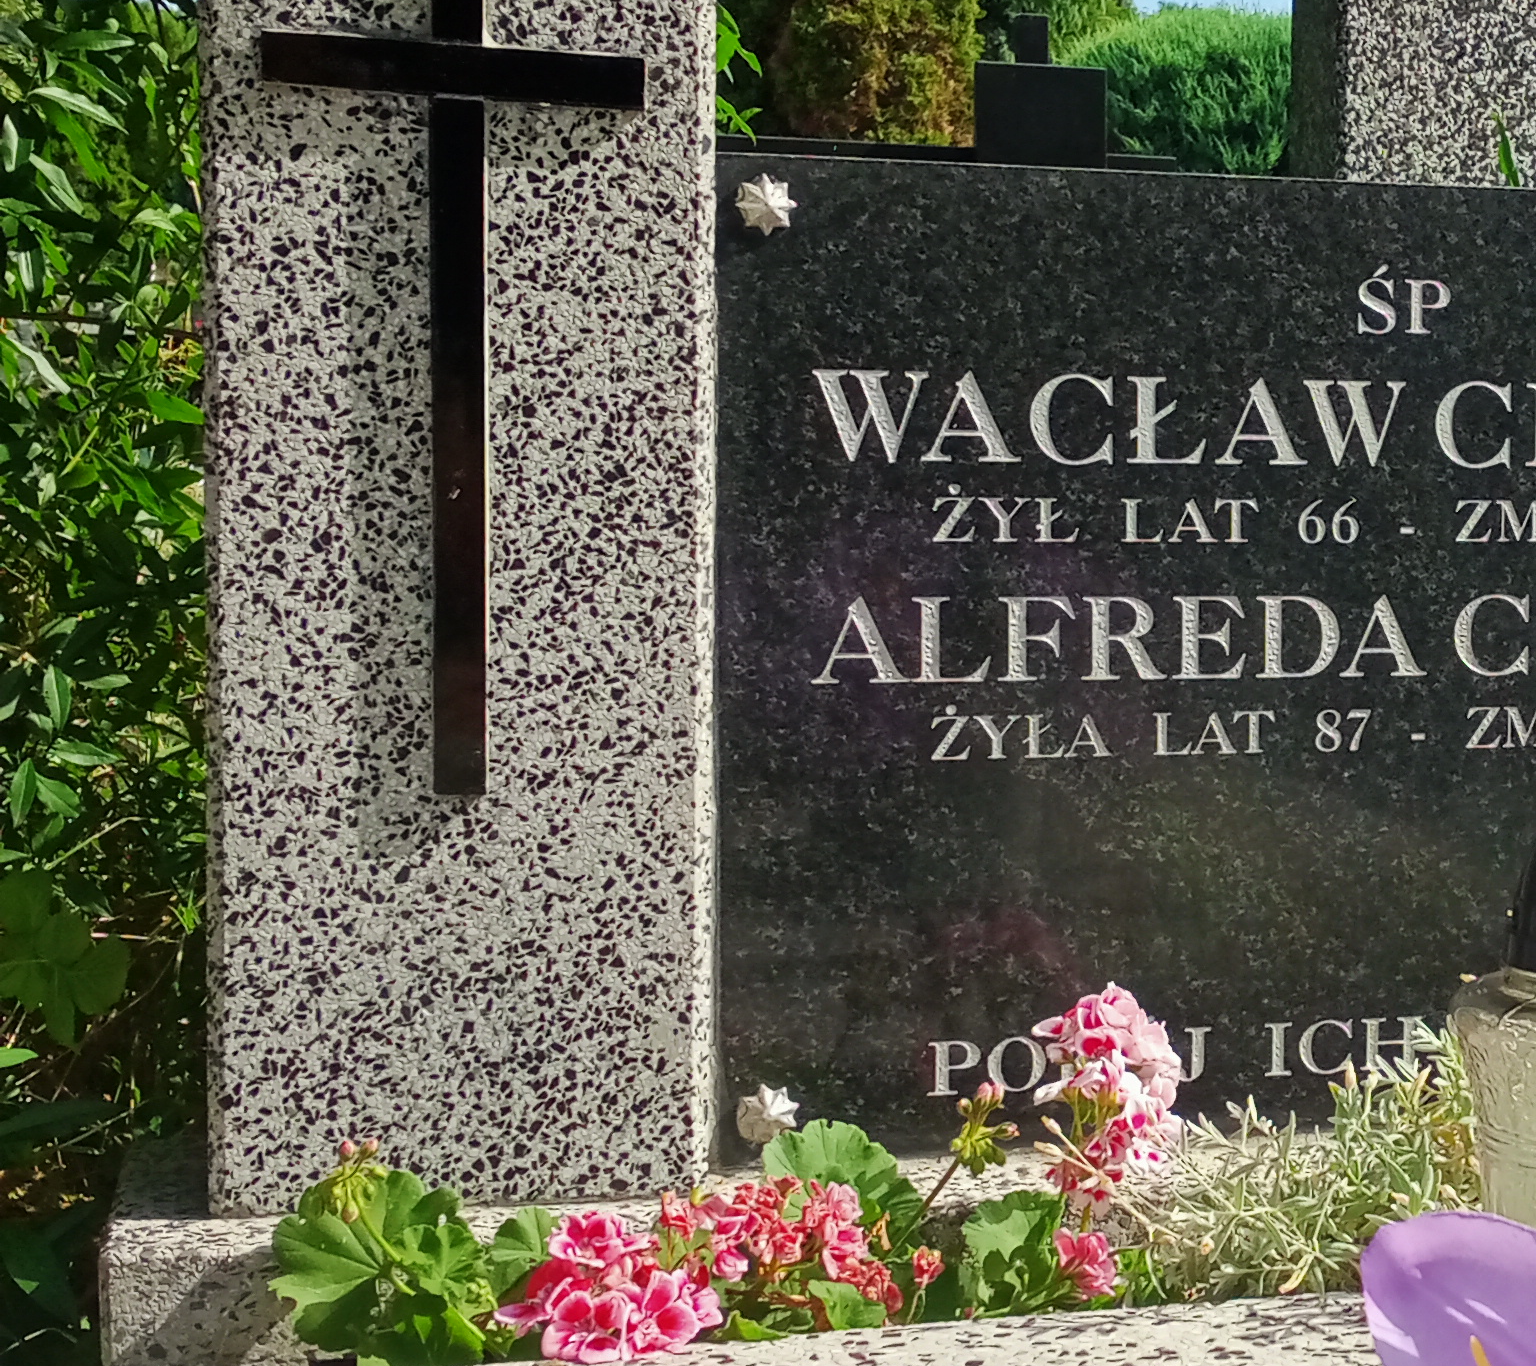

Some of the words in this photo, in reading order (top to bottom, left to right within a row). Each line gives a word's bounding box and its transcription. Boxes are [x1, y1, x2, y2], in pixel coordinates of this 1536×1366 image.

[1356, 264, 1451, 336] ŚP
[811, 369, 1406, 467] WACŁAW
[932, 484, 1079, 544] ŻYŁ
[1121, 498, 1259, 544] LAT
[1298, 498, 1360, 545] 66
[810, 594, 1427, 685] ALFREDA
[931, 705, 1111, 761] ŻYŁA
[1153, 710, 1276, 756] LAT
[1315, 709, 1371, 753] 87
[926, 1026, 1212, 1097] POJ
[1264, 1015, 1424, 1077] ICH
